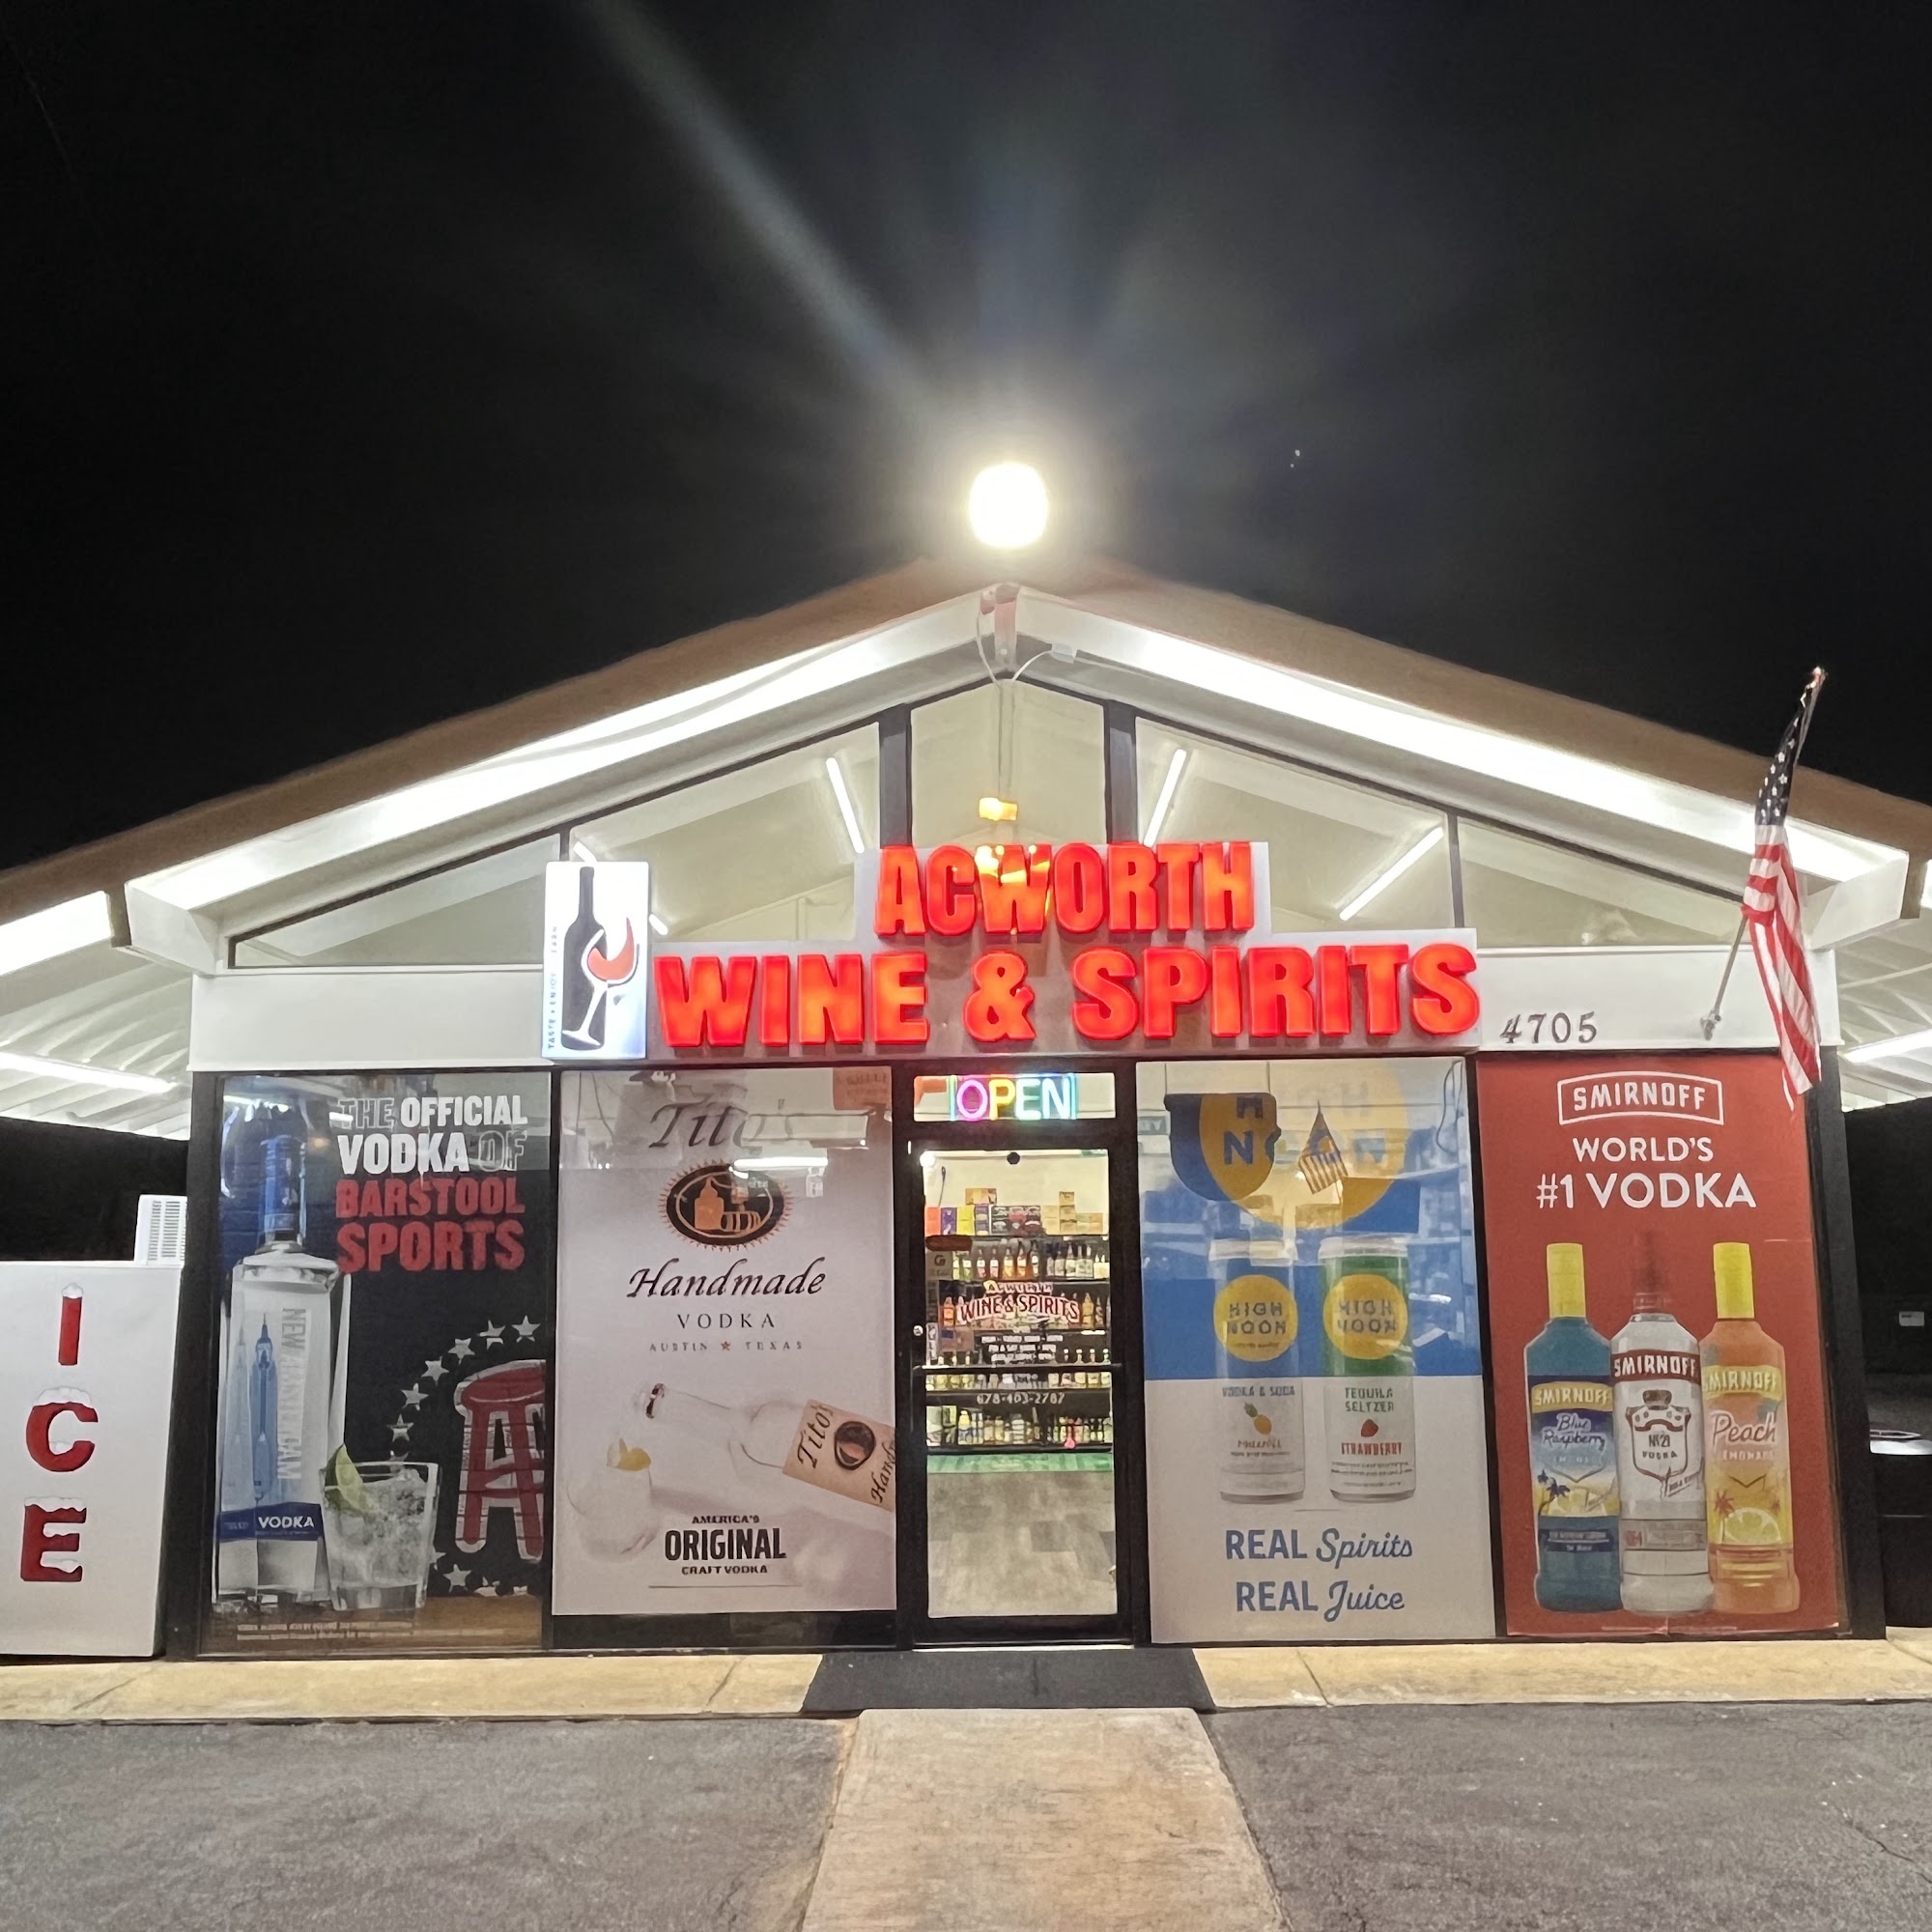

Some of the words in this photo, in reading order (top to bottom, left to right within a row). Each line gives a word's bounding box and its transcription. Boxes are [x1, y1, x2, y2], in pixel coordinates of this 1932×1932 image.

[874, 841, 1255, 937] ACWORTH
[653, 952, 929, 1047] WINE
[962, 950, 1037, 1043] &
[1071, 943, 1480, 1040] SPIRITS
[1499, 1011, 1598, 1044] 4705
[338, 1097, 395, 1129] THE
[401, 1095, 527, 1127] OFFICIAL
[956, 1078, 1070, 1121] OPEN
[1573, 1081, 1706, 1112] SMIRNOFF
[337, 1132, 469, 1175] VODKA
[478, 1130, 527, 1172] OF
[1572, 1136, 1714, 1162] WORLD'S
[335, 1177, 526, 1217] BARSTOOL
[1536, 1173, 1574, 1208] #1
[1585, 1172, 1757, 1208] VODKA
[337, 1219, 525, 1274] SPORTS
[627, 1257, 826, 1297] Handmade
[677, 1313, 775, 1329] VODKA
[958, 1295, 1003, 1324] WINE
[1017, 1294, 1080, 1322] SPIRITS
[1229, 1302, 1283, 1318] HIGH
[1338, 1299, 1393, 1316] HIGH
[1227, 1321, 1286, 1335] NOON
[649, 1342, 708, 1351] AUSTIN
[745, 1341, 803, 1350] TEXAS
[1614, 1354, 1695, 1378] SMIRNOFF
[1345, 1387, 1393, 1399] TEQUILA
[1534, 1387, 1608, 1406] SMIRNOFF
[20, 1283, 99, 1582] ICE
[1709, 1411, 1776, 1446] Peach
[258, 1516, 314, 1529] VODKA
[692, 1515, 760, 1524] AMERICA'S
[665, 1527, 787, 1561] ORIGINAL
[1226, 1529, 1308, 1560] REAL
[1316, 1528, 1413, 1570] Spirits
[681, 1566, 722, 1576] CRAFT
[724, 1565, 768, 1575] VODKA
[1236, 1581, 1319, 1612] REAL
[1323, 1580, 1406, 1623] Juice
